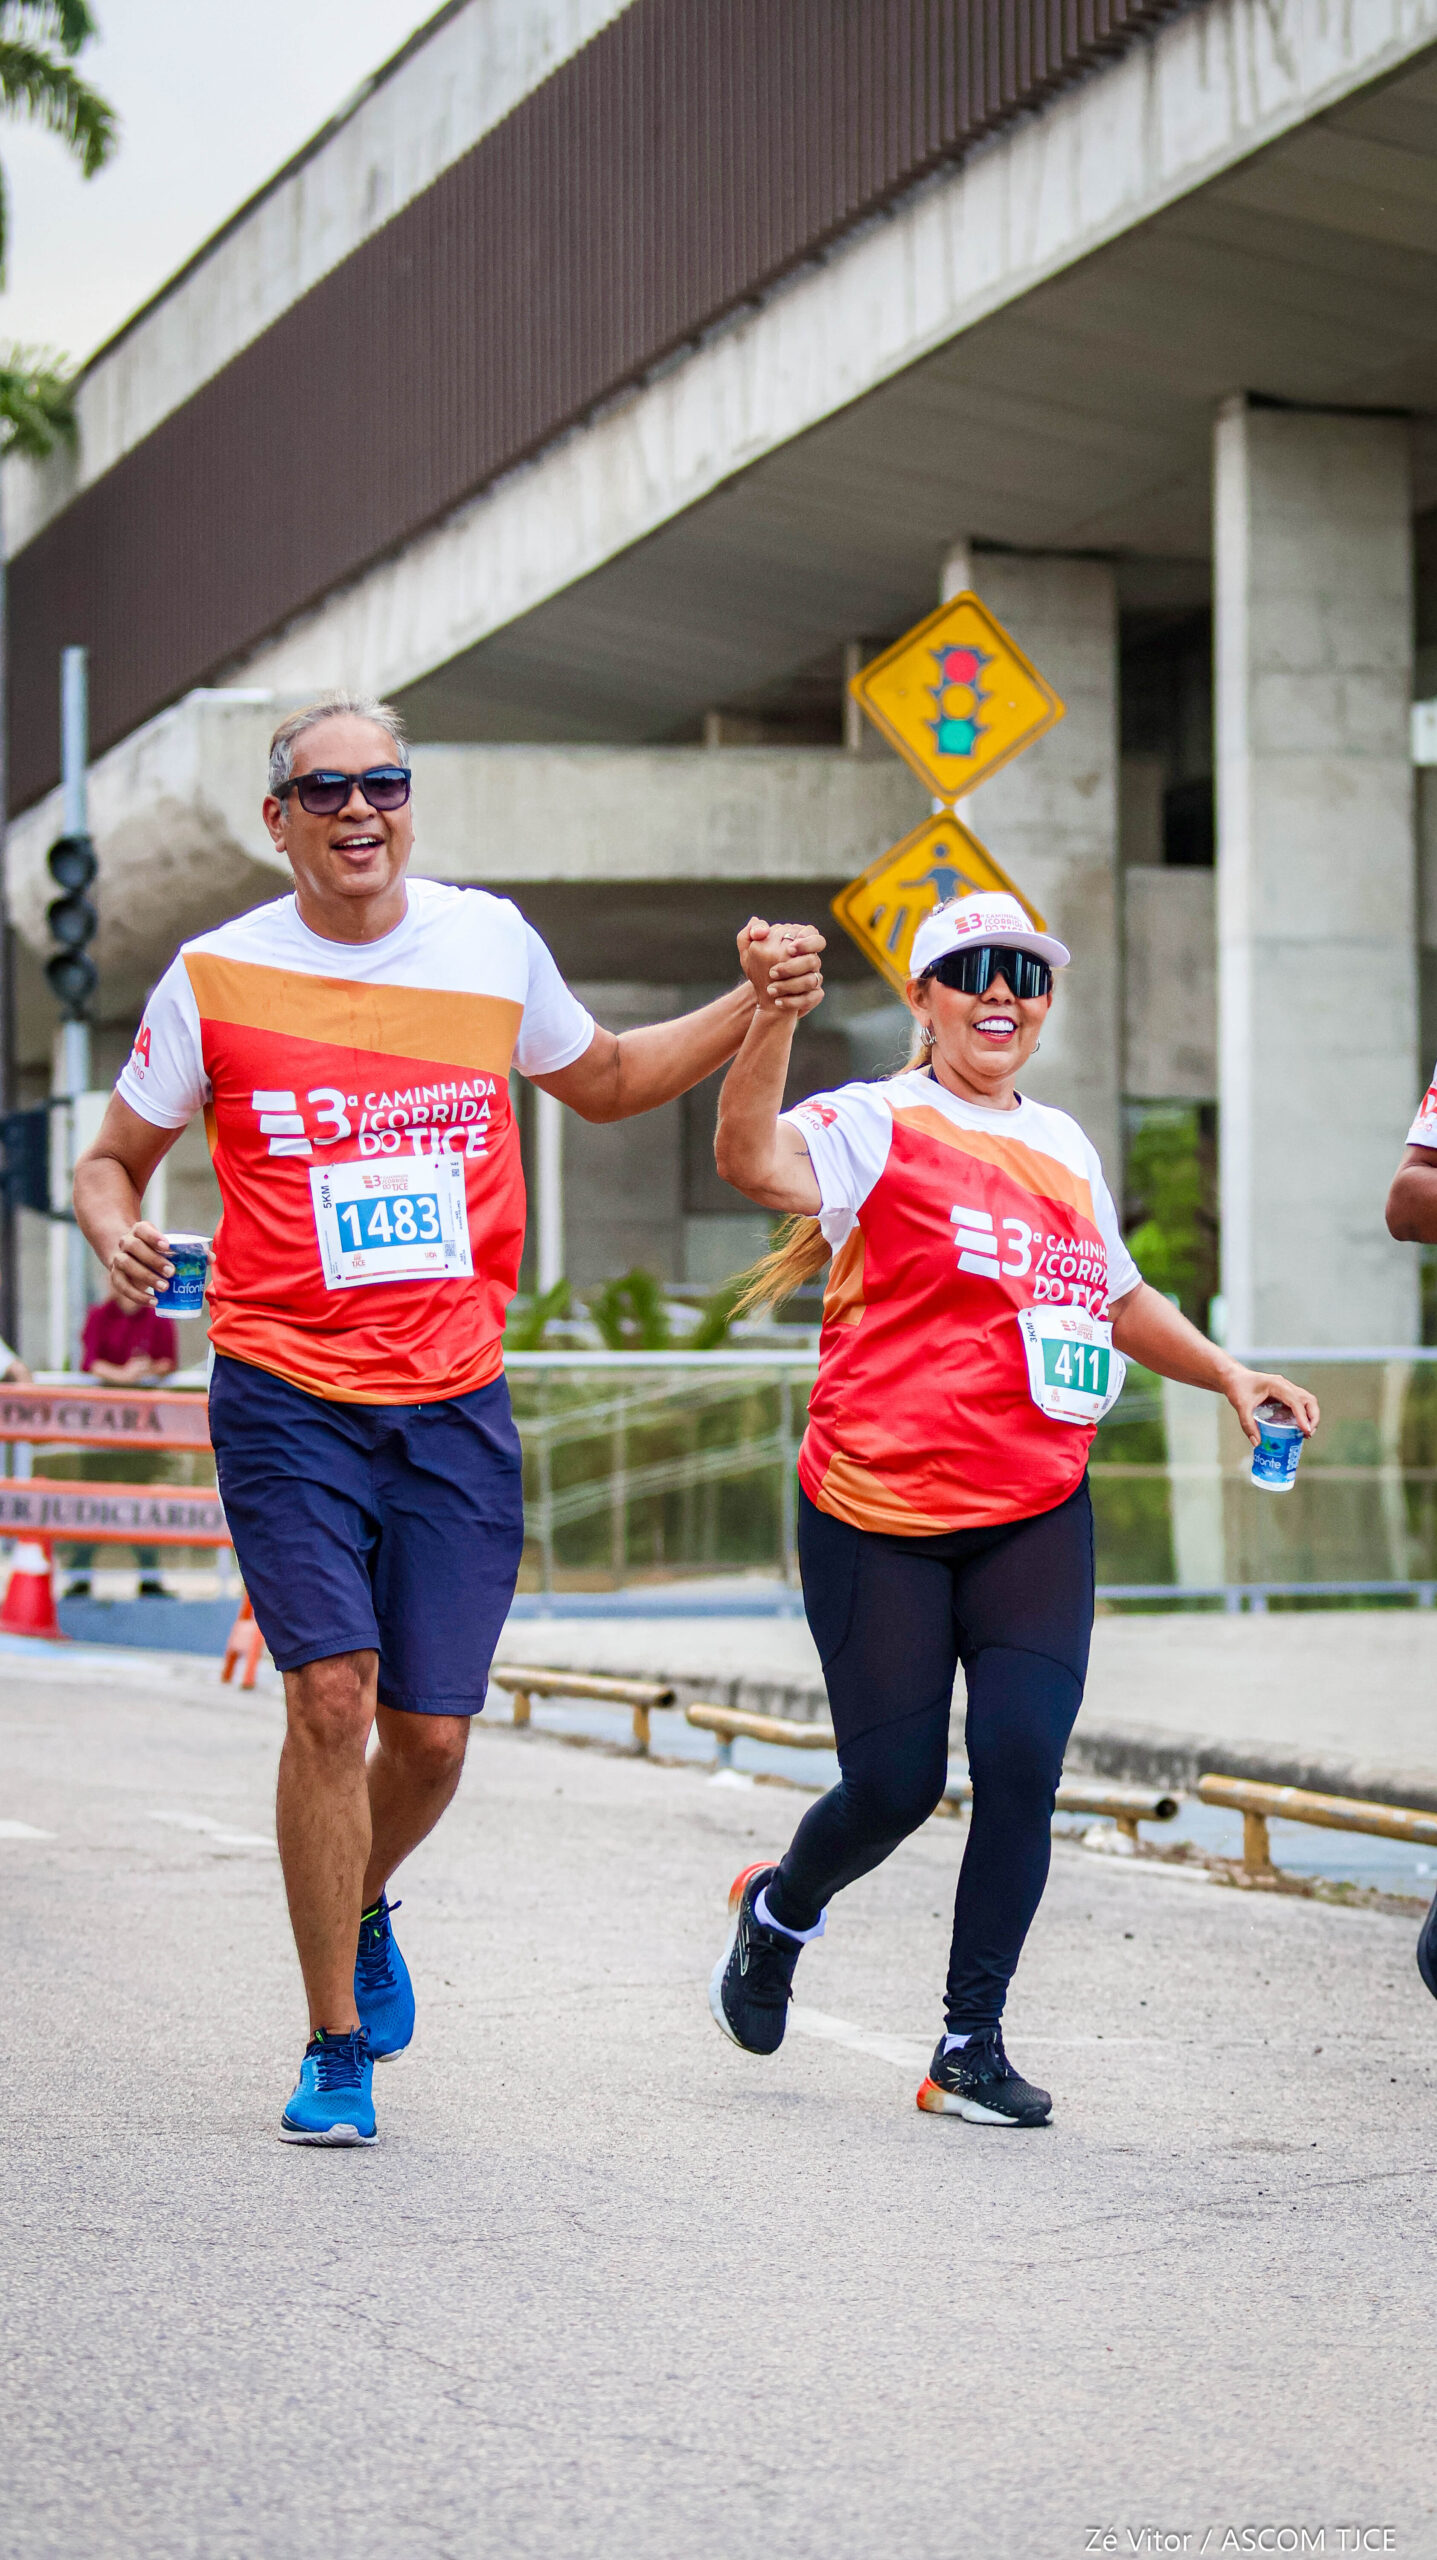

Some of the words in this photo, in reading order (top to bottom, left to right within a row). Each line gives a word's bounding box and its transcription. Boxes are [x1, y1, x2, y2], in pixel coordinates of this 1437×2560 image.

[364, 1078, 497, 1111] CAMINHADA
[358, 1099, 492, 1134] /CORRIDA
[358, 1131, 401, 1156] DO
[321, 1185, 332, 1209] 5KM
[341, 1197, 440, 1247] 1483
[1033, 1274, 1065, 1301] DO
[1026, 1322, 1038, 1343] 3KM
[1054, 1343, 1099, 1391] 411
